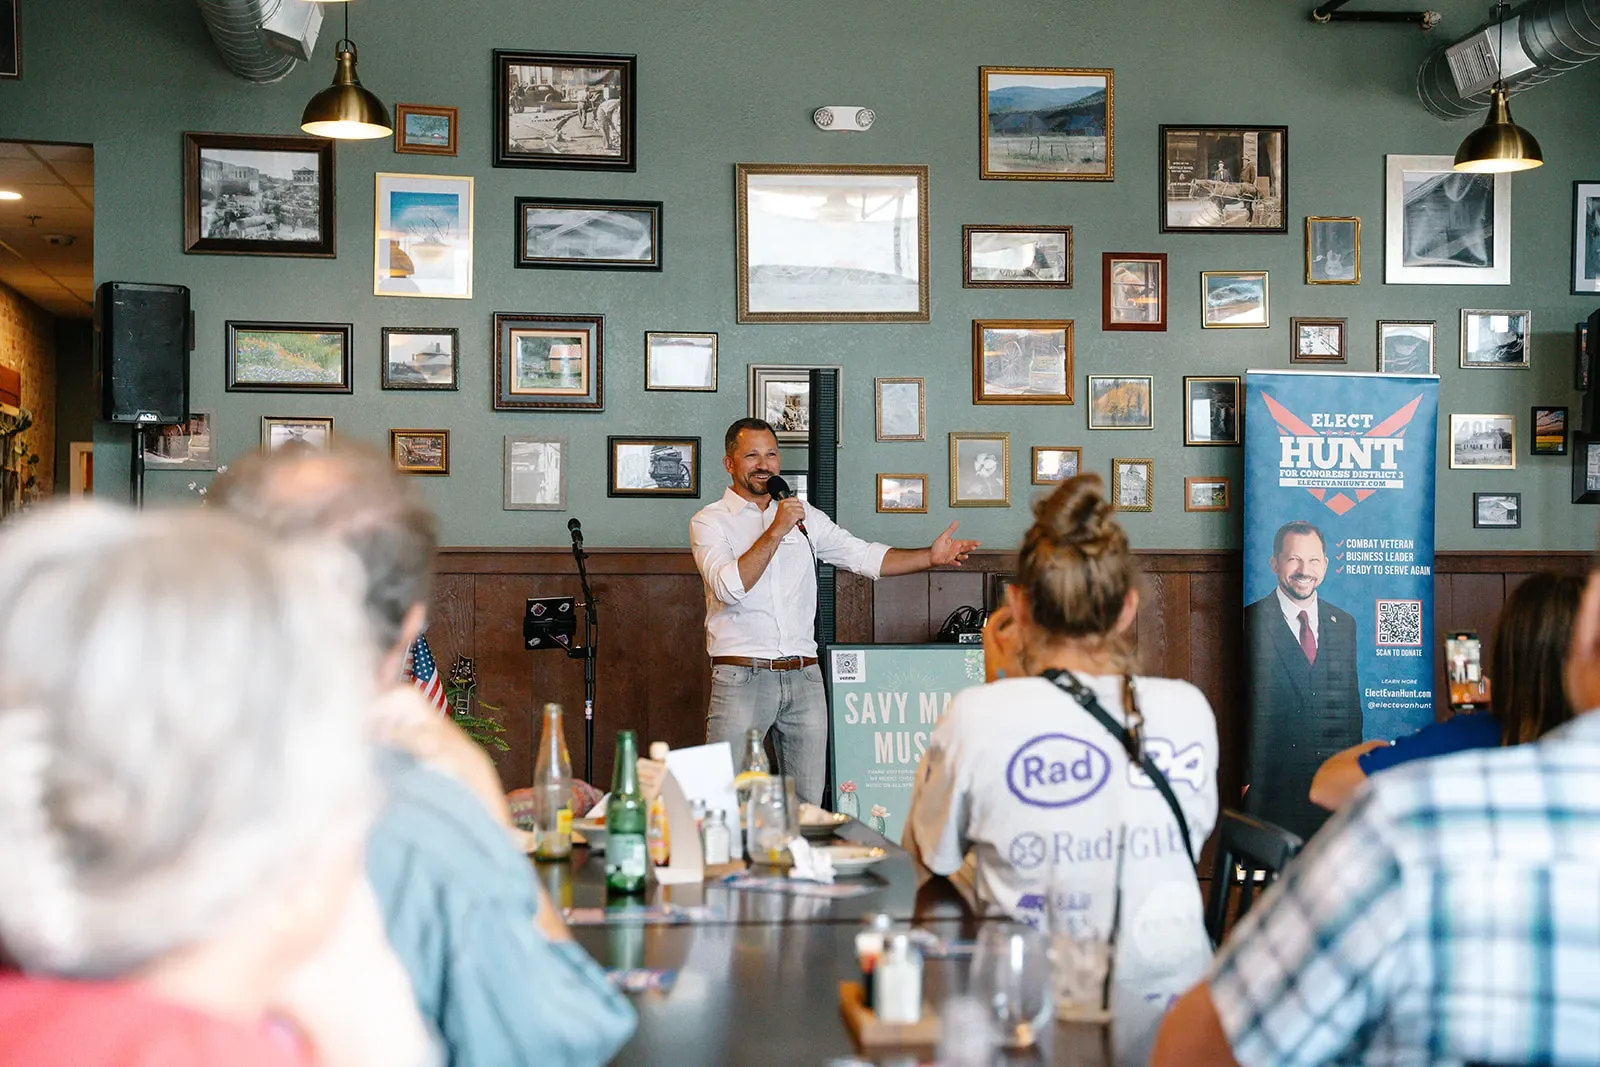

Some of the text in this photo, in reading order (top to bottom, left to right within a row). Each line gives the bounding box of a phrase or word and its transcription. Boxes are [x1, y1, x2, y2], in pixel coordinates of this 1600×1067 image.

[1311, 413, 1373, 428] ELECT
[1279, 436, 1404, 470] HUNT
[1279, 469, 1404, 479] FOR CONGRESS DISTRICT 3
[1346, 539, 1414, 549] COMBAT VETERAN
[1346, 551, 1414, 562] BUSINESS LEADER
[1346, 564, 1431, 576] READY TO SERVE AGAIN
[1375, 648, 1422, 657] SCAN TO DONATE
[1365, 688, 1432, 698] ElectEvanHunt.com
[845, 692, 908, 724] SAVY
[1367, 701, 1432, 709] @electevanhunt
[874, 731, 934, 763] MUS
[1023, 749, 1093, 789] Rad
[1052, 827, 1113, 865] Rad
